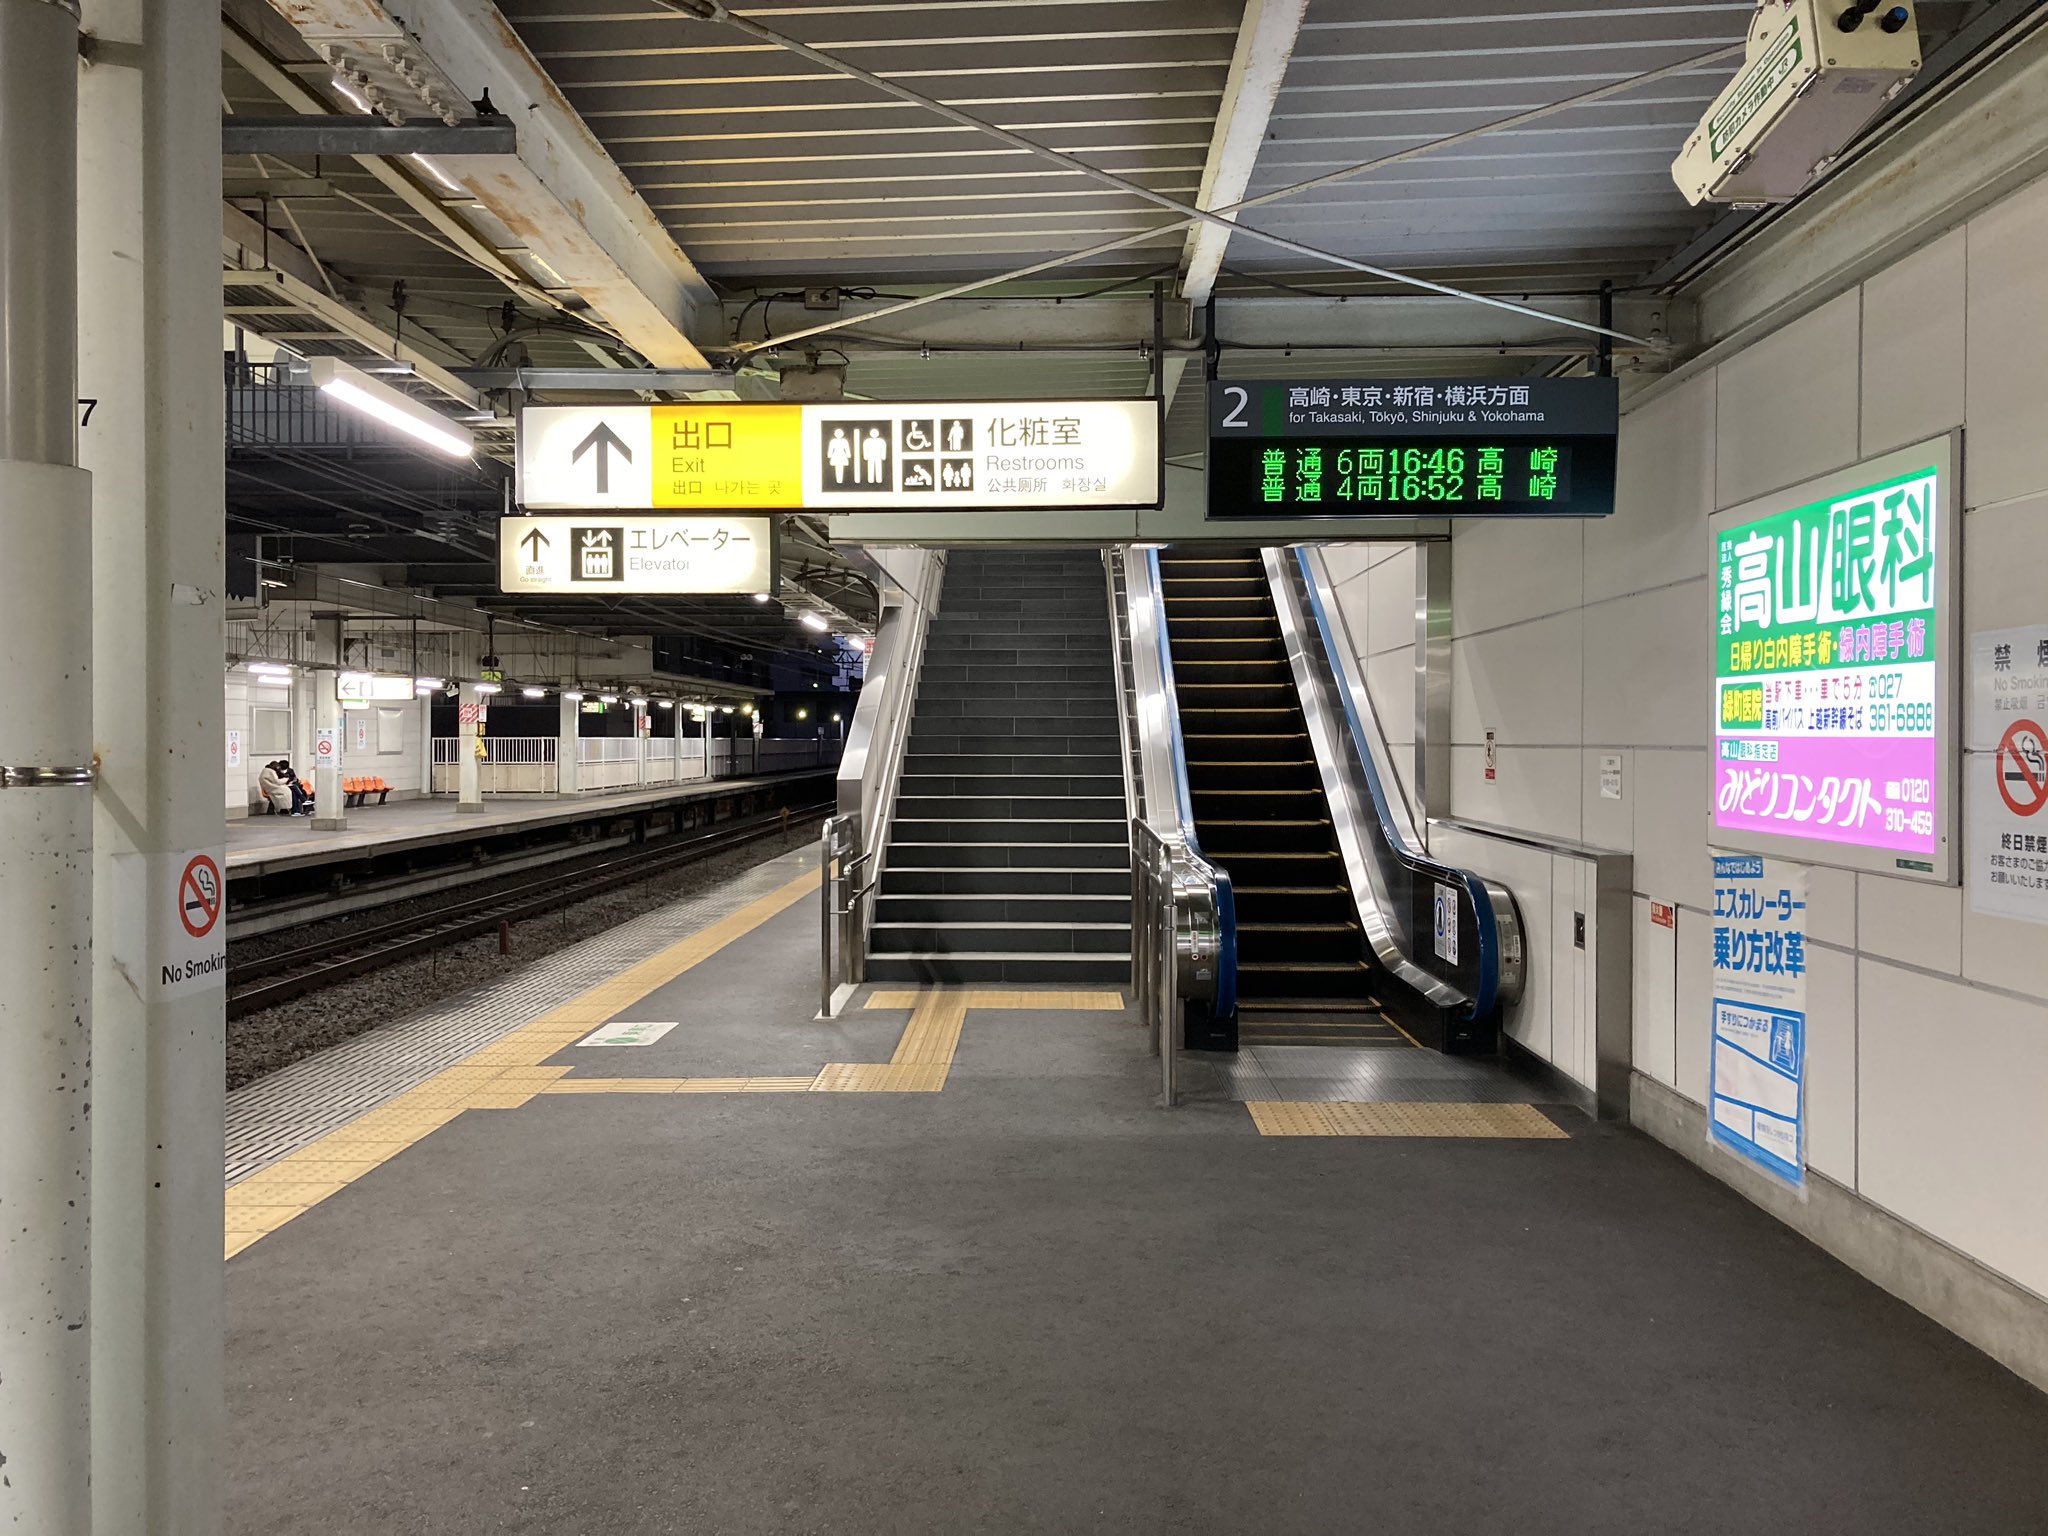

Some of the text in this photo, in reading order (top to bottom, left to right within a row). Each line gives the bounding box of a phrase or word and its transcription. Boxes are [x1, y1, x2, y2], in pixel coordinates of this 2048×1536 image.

[1222, 387, 1248, 428] 2
[1289, 385, 1531, 408] 高崎・東京・新宿・横浜方面
[78, 399, 98, 427] 7
[1289, 412, 1305, 423] for
[1309, 411, 1365, 425] Takasaki,
[1412, 410, 1464, 424] Shinjuku
[1468, 411, 1477, 422] &
[1481, 410, 1545, 422] Yokohama
[673, 420, 732, 450] 出口
[987, 417, 1082, 448] 化粧室
[672, 457, 705, 473] Exit
[987, 455, 1085, 471] Restrooms
[1261, 448, 1322, 476] 普通
[673, 480, 703, 495] 出口
[715, 480, 782, 495] 나가는 곳
[1062, 476, 1107, 493] 화장실
[1261, 475, 1322, 503] 普通
[630, 528, 751, 551] エレベーター
[630, 556, 690, 572] Elevator
[1735, 482, 1934, 633] 高山眼科
[1994, 676, 2008, 691] No
[1869, 702, 1933, 732] 361-6888
[1719, 767, 1883, 829] みどりコンタクト
[1901, 778, 1930, 804] 0120
[1885, 807, 1933, 836] 310-459
[1713, 888, 1806, 921] エスカレーター
[1713, 926, 1806, 979] 乗り方改革
[162, 965, 182, 985] No
